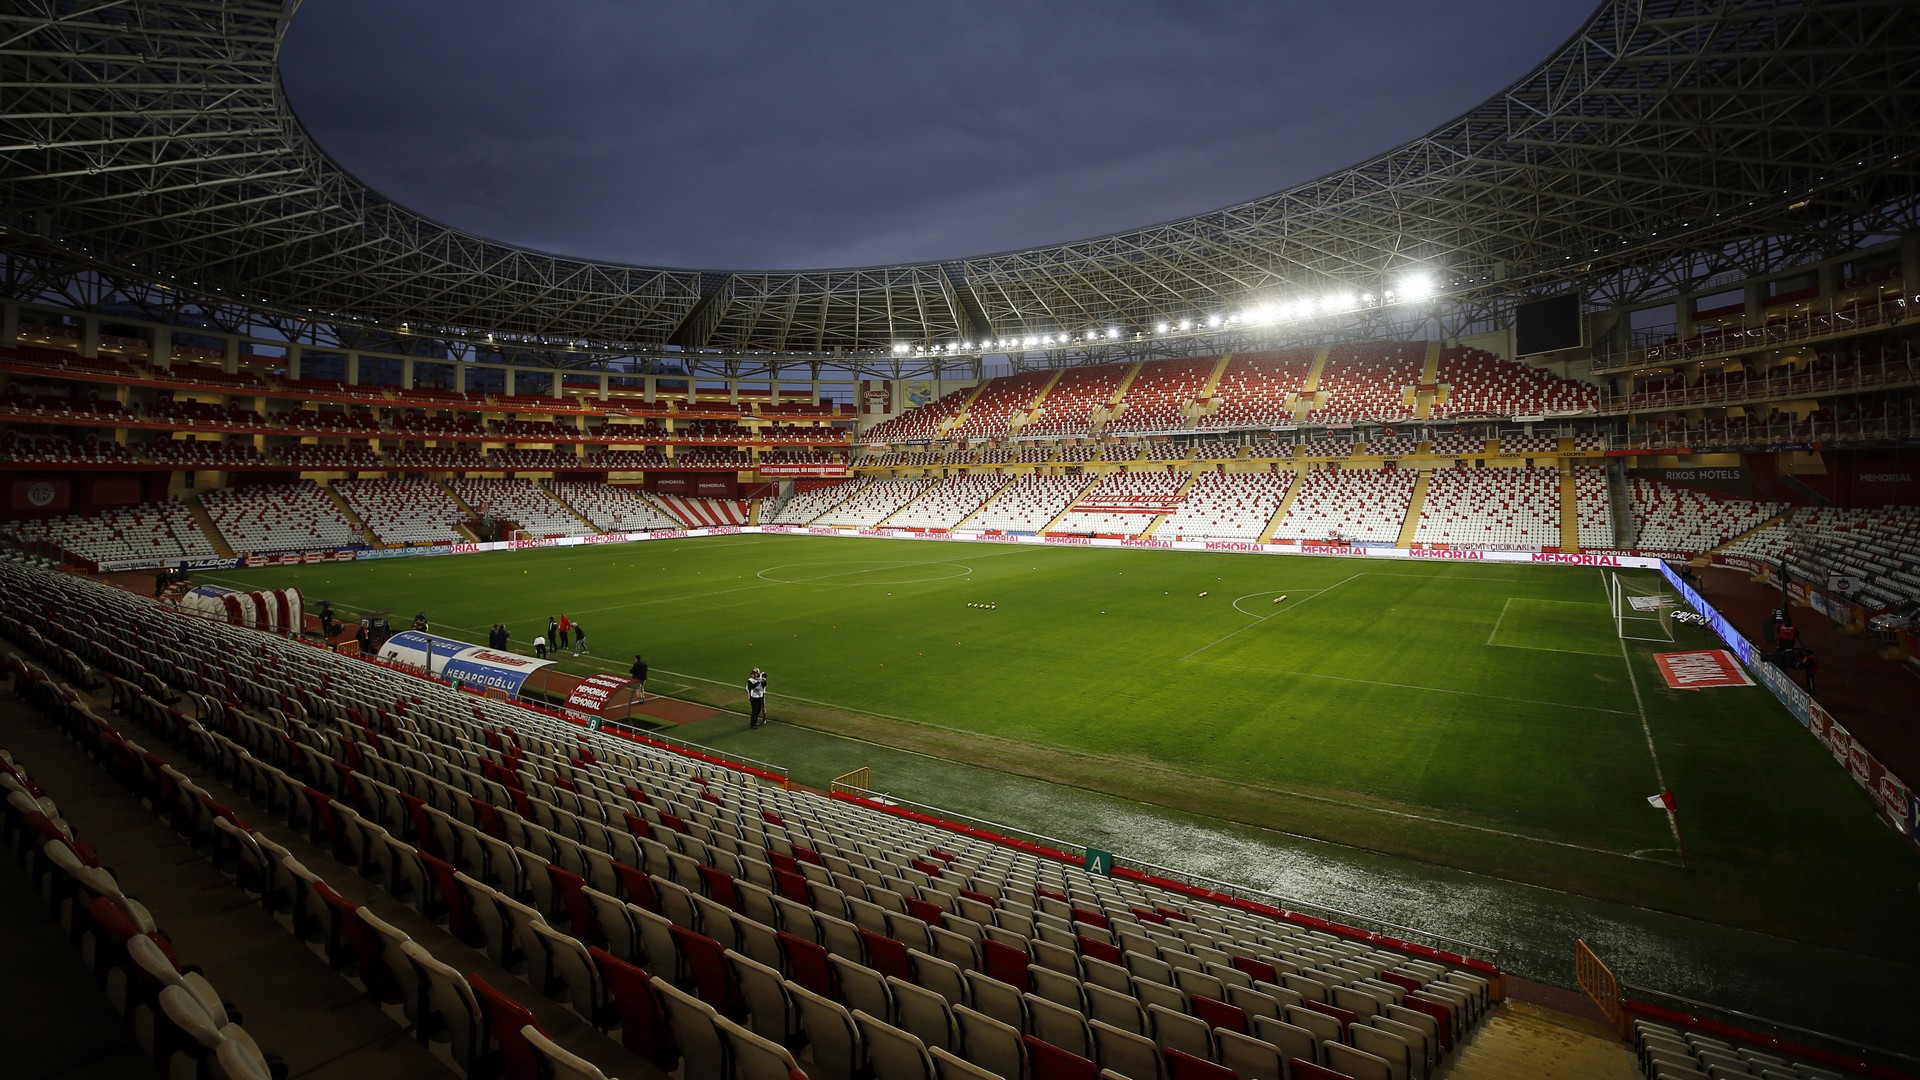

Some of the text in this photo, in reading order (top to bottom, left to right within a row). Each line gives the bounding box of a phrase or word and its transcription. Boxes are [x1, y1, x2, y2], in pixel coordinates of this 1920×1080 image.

[1666, 470, 1740, 480] RIXOS HOTELS
[1859, 474, 1912, 482] MEMORIAL
[584, 534, 628, 544] MEMORIAL
[650, 530, 689, 539] MEMORIAL
[976, 534, 1018, 542] MEMORIAL
[1044, 537, 1091, 545] MEMORIAL
[1120, 540, 1172, 548] MEMORIAL
[1206, 542, 1264, 551] MEMORIAL
[1302, 545, 1367, 555] MEMORIAL
[1409, 549, 1484, 559] MEMORIAL
[1532, 552, 1622, 566] MEMORIAL
[1640, 551, 1686, 560] MEMORIAL
[187, 558, 238, 567] YILBOR
[586, 678, 620, 689] MEMORIAL
[576, 684, 609, 698] MEMORIAL
[568, 694, 601, 710] MEMORIAL
[590, 720, 597, 730] B
[1090, 856, 1103, 874] A
